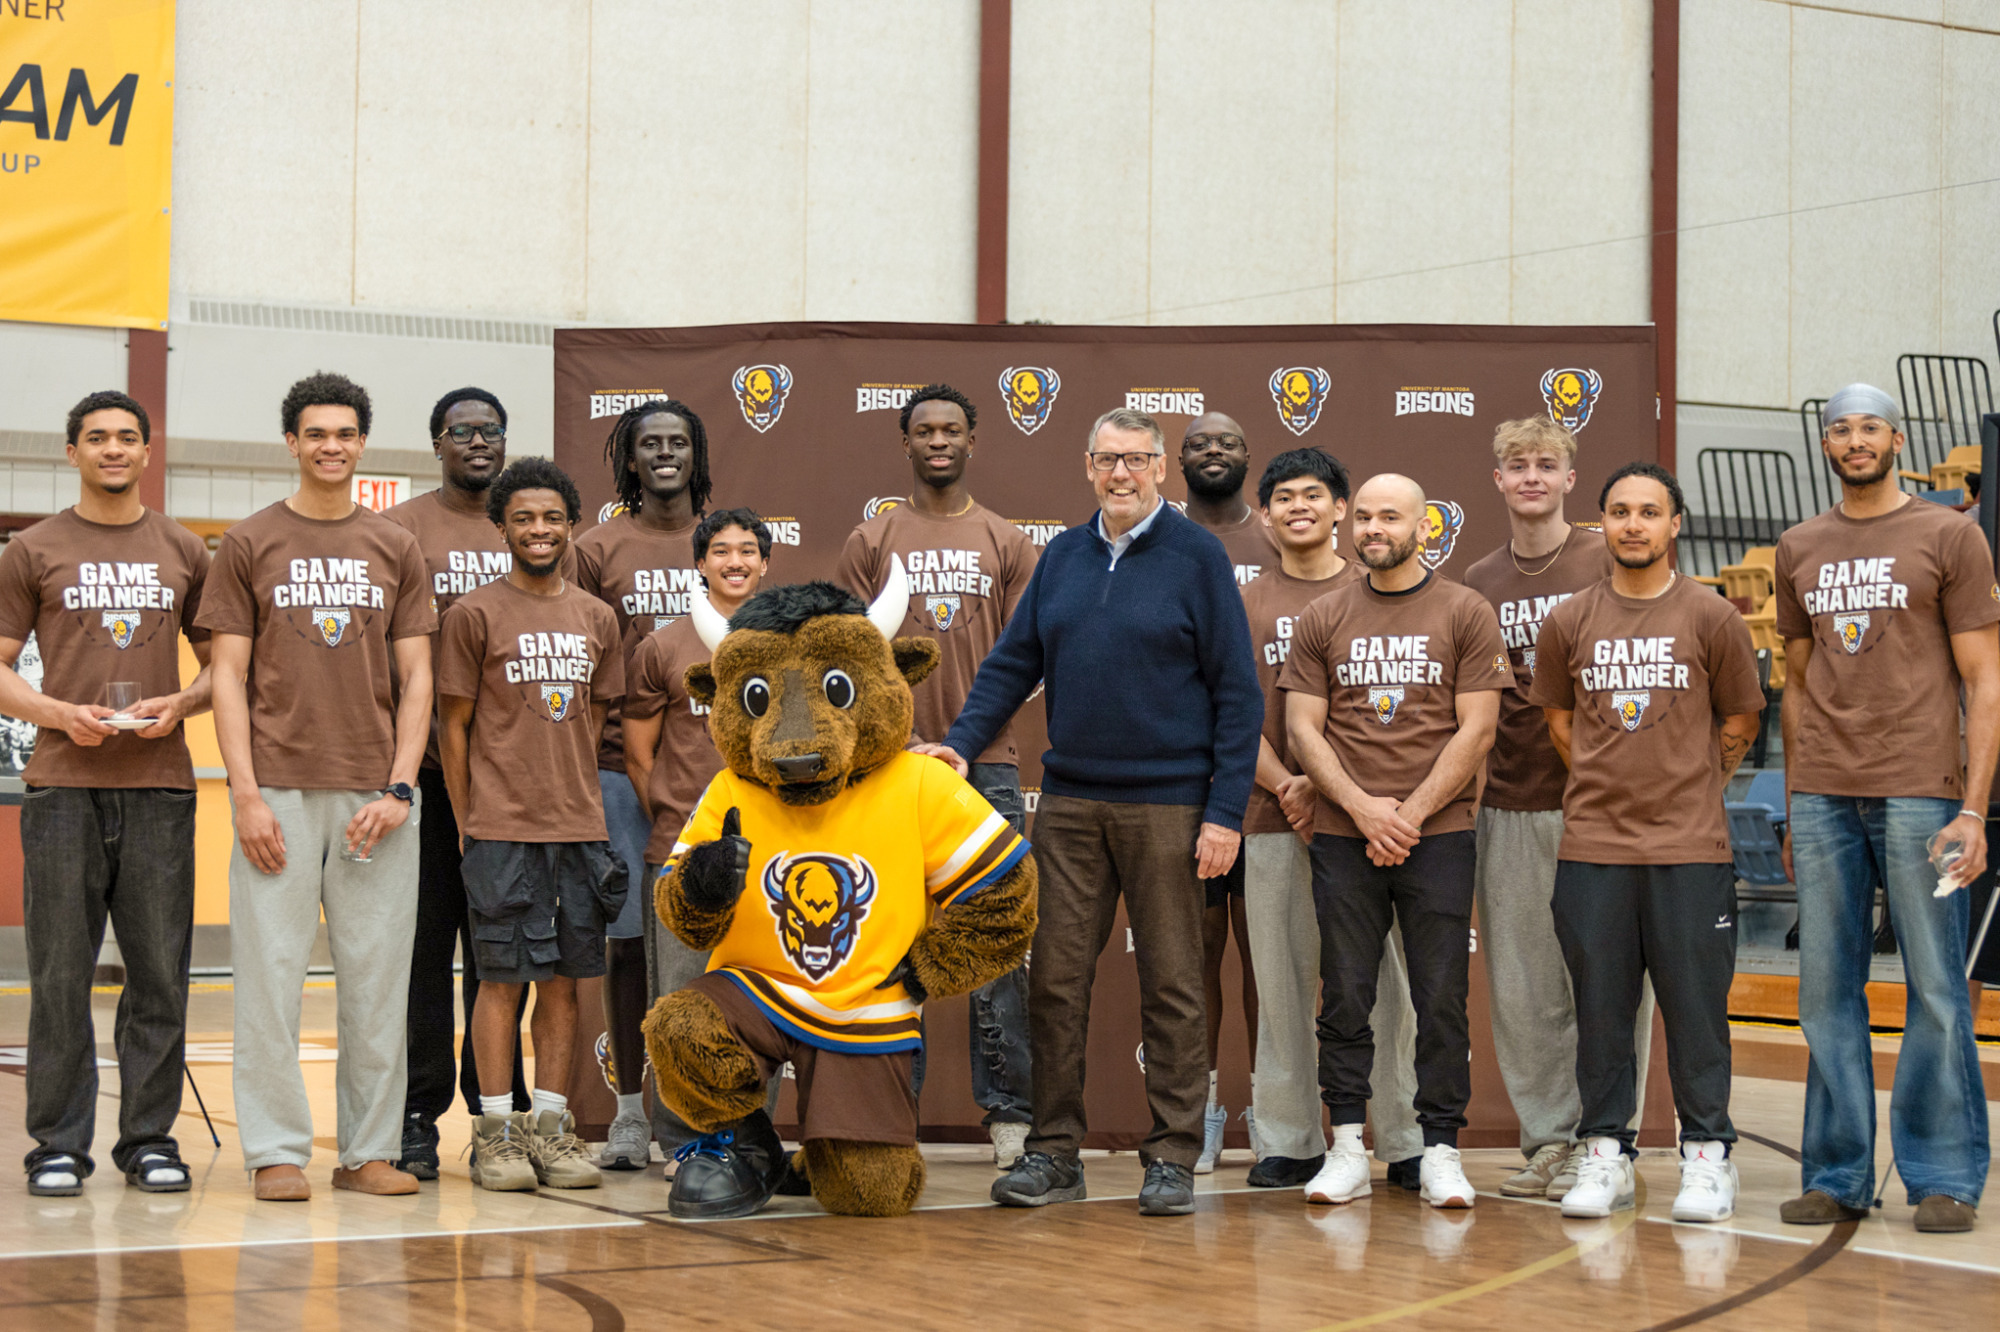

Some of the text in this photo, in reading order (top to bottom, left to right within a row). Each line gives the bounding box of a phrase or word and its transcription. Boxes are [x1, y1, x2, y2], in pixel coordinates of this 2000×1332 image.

[0, 0, 64, 21] NER
[0, 63, 139, 146] AM
[2, 153, 41, 174] UP
[1125, 392, 1204, 416] BISONS
[1395, 391, 1474, 417] BISONS
[290, 558, 370, 584] GAME
[908, 549, 981, 573] GAME
[1818, 558, 1896, 588] GAME
[80, 562, 162, 586] GAME
[906, 571, 994, 598] HANGER
[64, 586, 174, 610] CHANGER
[274, 582, 384, 609] CHANGER
[622, 593, 692, 615] CHANG
[926, 596, 961, 612] BISONS
[1804, 584, 1908, 616] CHANGER
[102, 612, 141, 628] BISONS
[312, 610, 350, 625] BISONS
[1834, 614, 1870, 632] BISONS
[518, 632, 589, 660] GAME
[1350, 636, 1430, 662] GAME
[1594, 637, 1676, 666] GAME
[1336, 660, 1442, 686] CHANGER
[1581, 664, 1690, 691] CHANGER
[541, 684, 574, 700] BISONS
[1370, 688, 1404, 704] BISONS
[1612, 692, 1650, 709] BISONS
